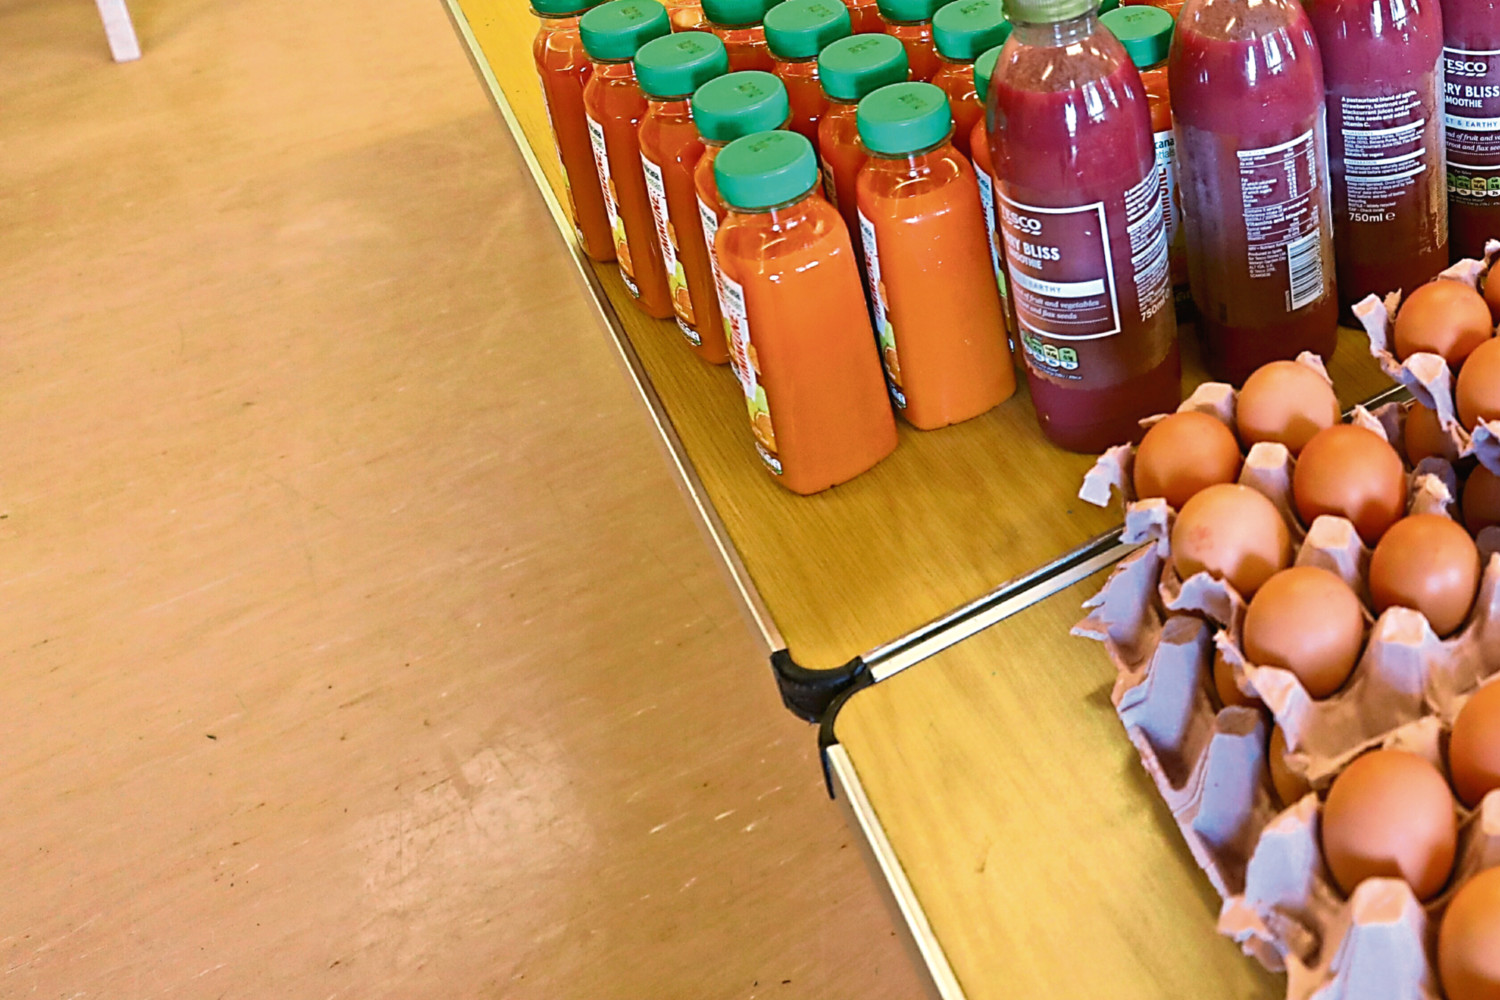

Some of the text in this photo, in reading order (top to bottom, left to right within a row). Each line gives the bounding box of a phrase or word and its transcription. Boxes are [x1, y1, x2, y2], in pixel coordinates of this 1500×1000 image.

[1465, 86, 1500, 98] BLISS
[1446, 96, 1483, 108] MOOTHIE
[1348, 212, 1383, 222] 750ml
[651, 194, 672, 262] IMMUNE
[1023, 242, 1061, 261] BLISS
[1060, 300, 1100, 310] vegetables
[1140, 297, 1166, 322] 750ml
[730, 315, 752, 385] IMMUNE
